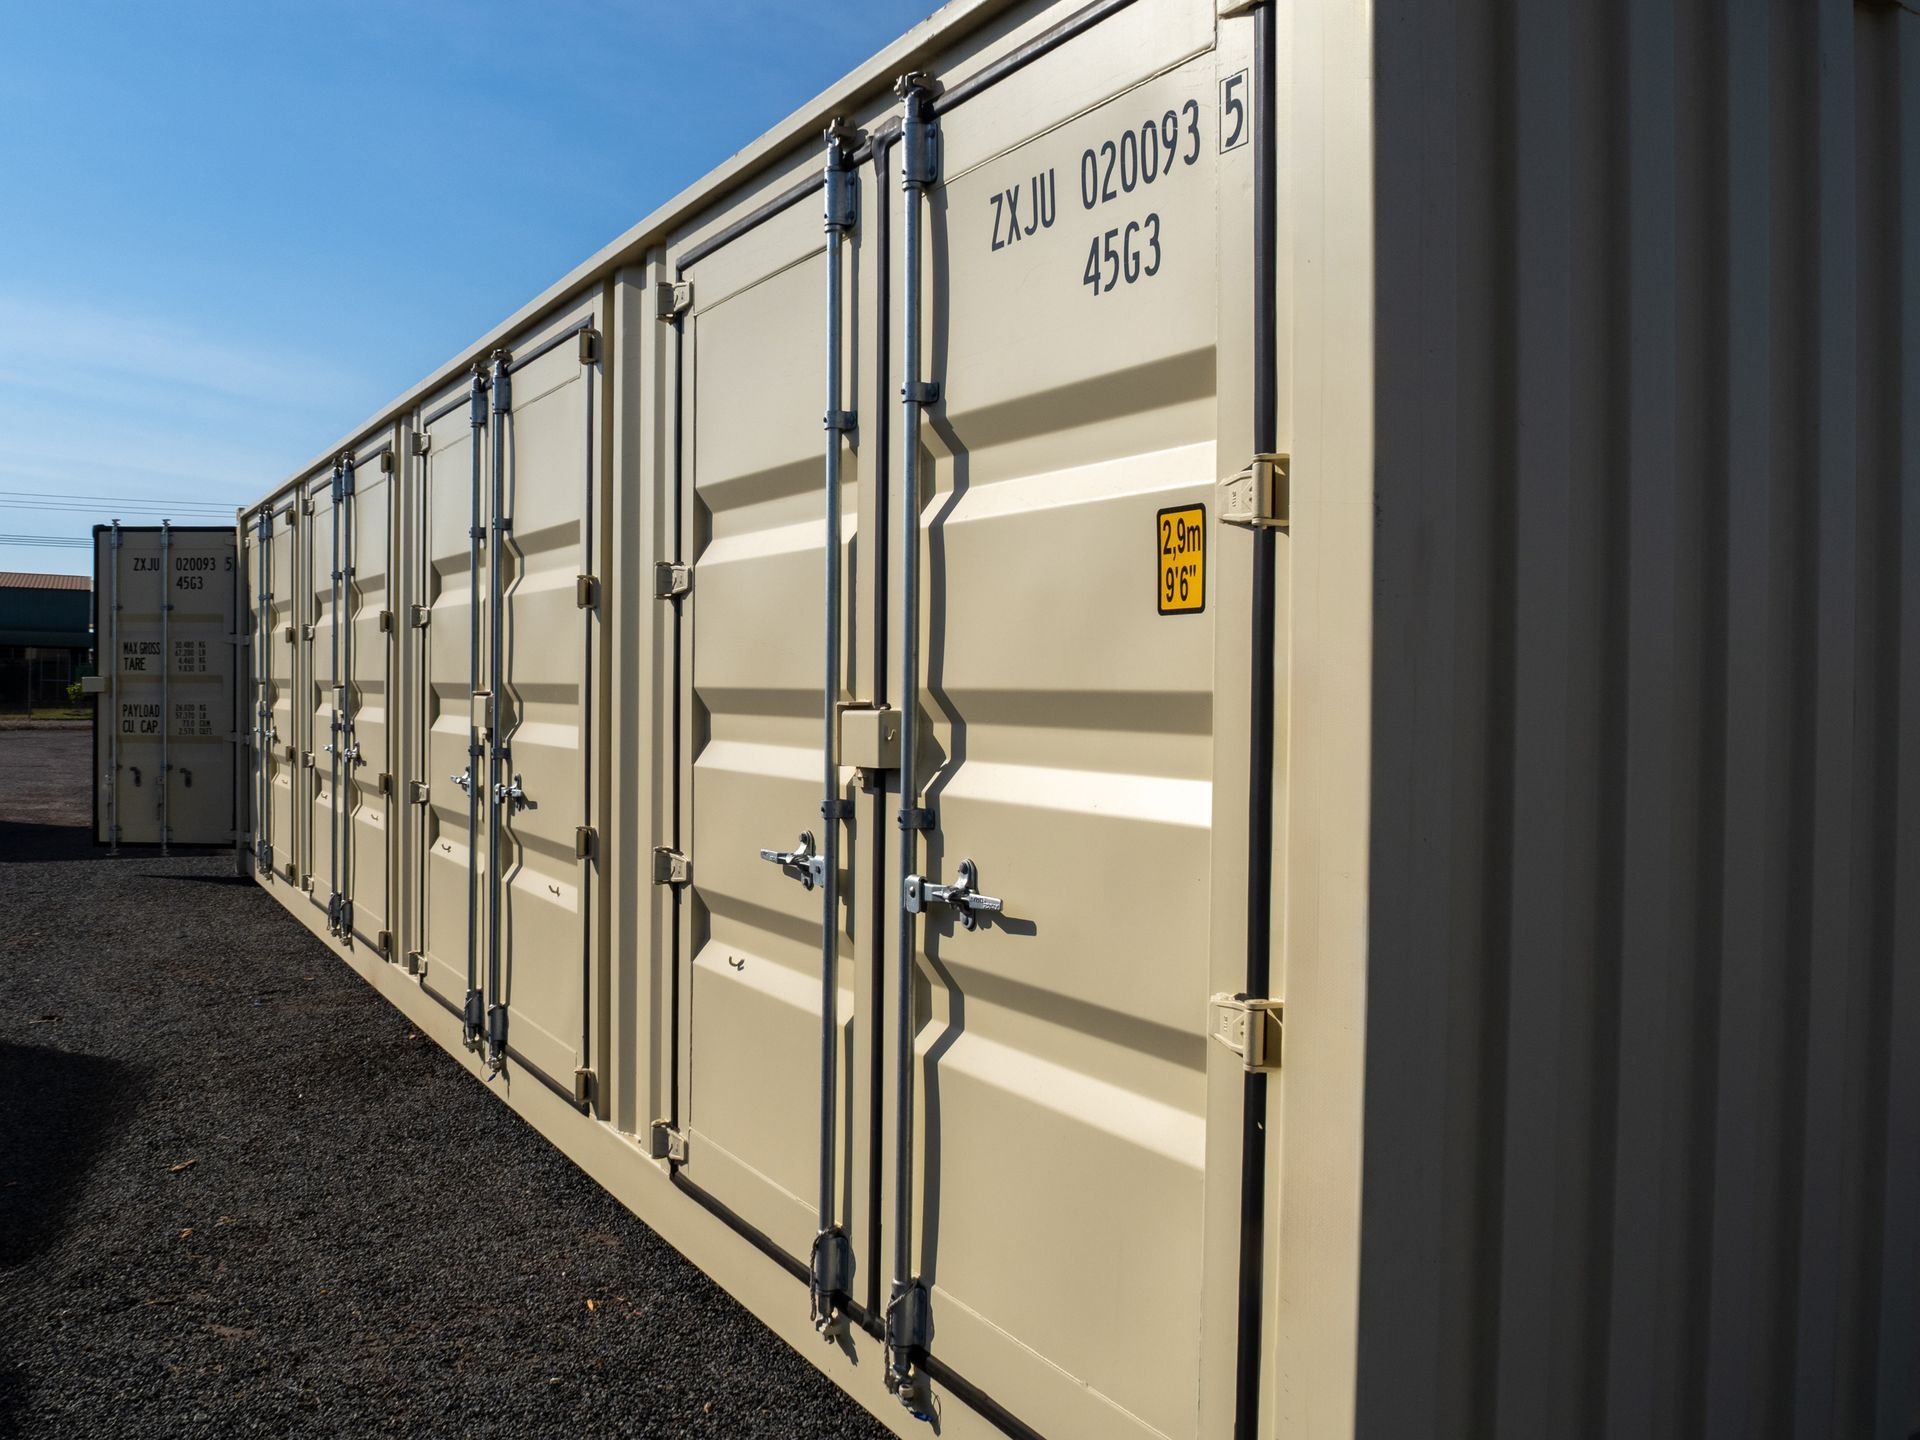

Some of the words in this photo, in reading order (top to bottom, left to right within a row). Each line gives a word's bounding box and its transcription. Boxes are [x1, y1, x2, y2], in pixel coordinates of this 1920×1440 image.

[989, 167, 1056, 252] ZXJU
[1080, 99, 1201, 210] 020093
[1224, 74, 1244, 148] 5
[1083, 212, 1161, 297] 45G3
[1162, 517, 1201, 561] 2,9m
[133, 557, 160, 572] ZXJU
[175, 557, 216, 572] 020093
[225, 556, 233, 572] 5
[176, 576, 204, 590] 45G3
[123, 642, 138, 655] MAX
[139, 642, 161, 656] GROSS
[123, 657, 146, 671] TARE
[123, 704, 160, 718] PAYLOAD
